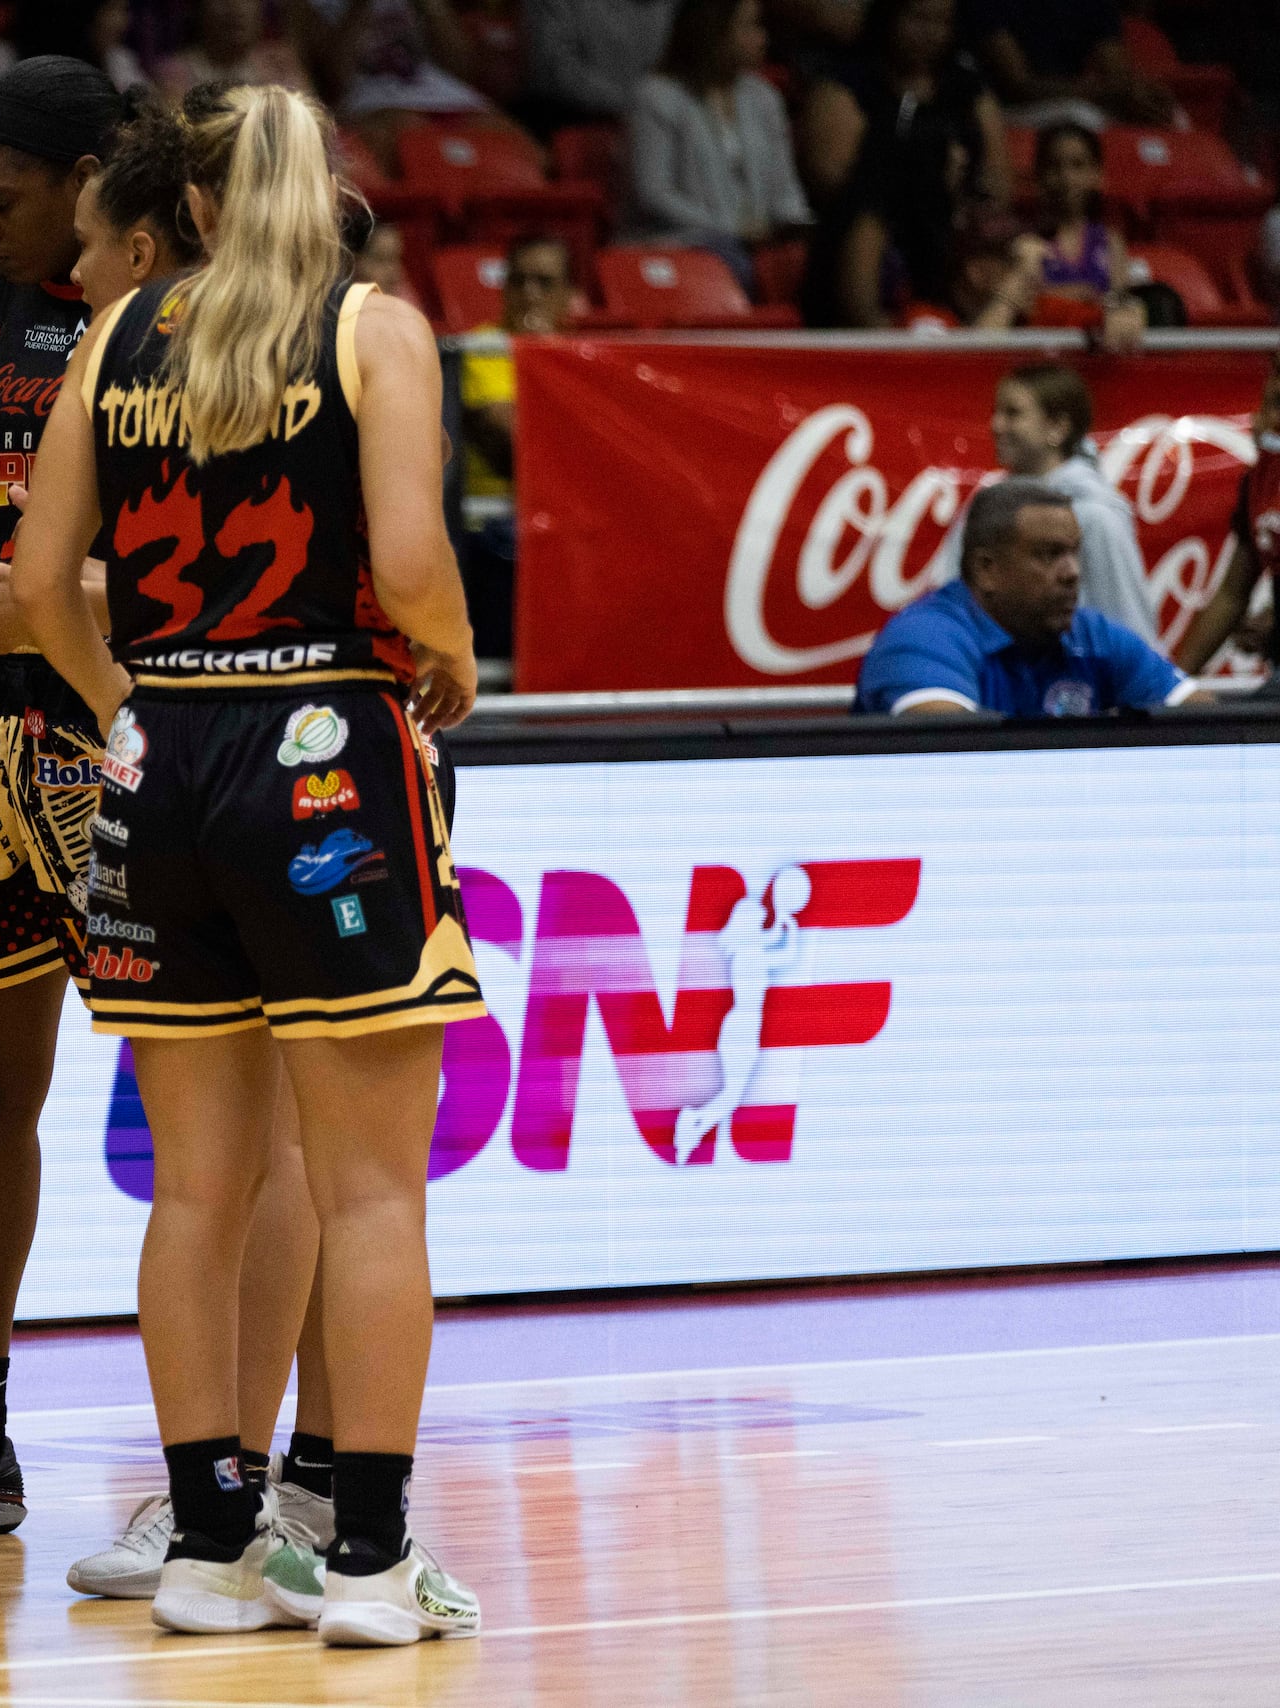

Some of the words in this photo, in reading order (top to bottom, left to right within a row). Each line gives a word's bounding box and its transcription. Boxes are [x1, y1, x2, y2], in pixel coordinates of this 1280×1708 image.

[24, 329, 72, 345] TURISMO
[24, 341, 49, 351] PUERTO
[49, 344, 66, 352] RICO
[113, 462, 314, 645] 32
[298, 787, 355, 809] marco's
[339, 900, 361, 930] E
